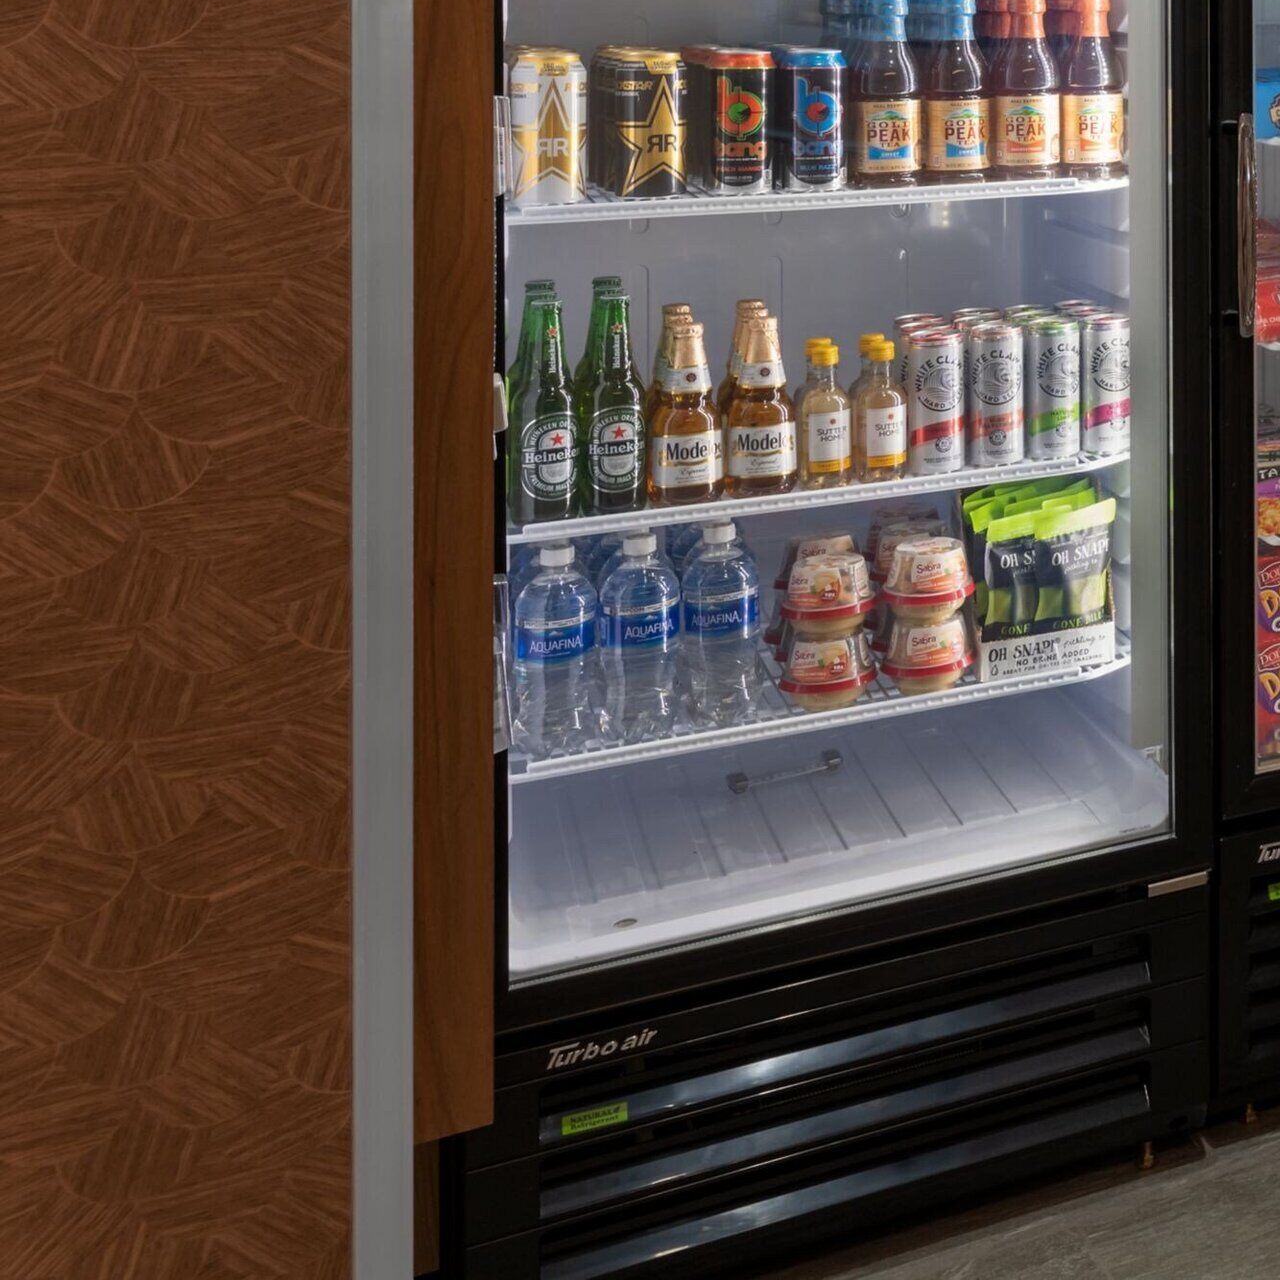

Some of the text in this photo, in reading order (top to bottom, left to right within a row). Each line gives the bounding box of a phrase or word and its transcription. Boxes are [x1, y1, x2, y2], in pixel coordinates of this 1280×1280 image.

[867, 127, 910, 143] PEAK
[945, 126, 985, 141] PEAK
[1006, 122, 1046, 137] PEAK
[881, 139, 900, 147] TEA
[1036, 347, 1055, 378] WHITE
[1091, 342, 1110, 374] WHITE
[915, 360, 934, 392] WHITE
[972, 354, 988, 386] WHITE
[1001, 552, 1019, 569] OH
[1052, 550, 1069, 566] OH
[916, 562, 941, 574] Sabra
[692, 611, 740, 626] AQUAFINA
[624, 619, 674, 640] AQUAFINA
[530, 636, 583, 654] AQUAFINA
[912, 634, 937, 648] Sabra
[988, 647, 1007, 663] OH
[1062, 648, 1089, 659] ADDED
[547, 1028, 658, 1070] Turbo air
